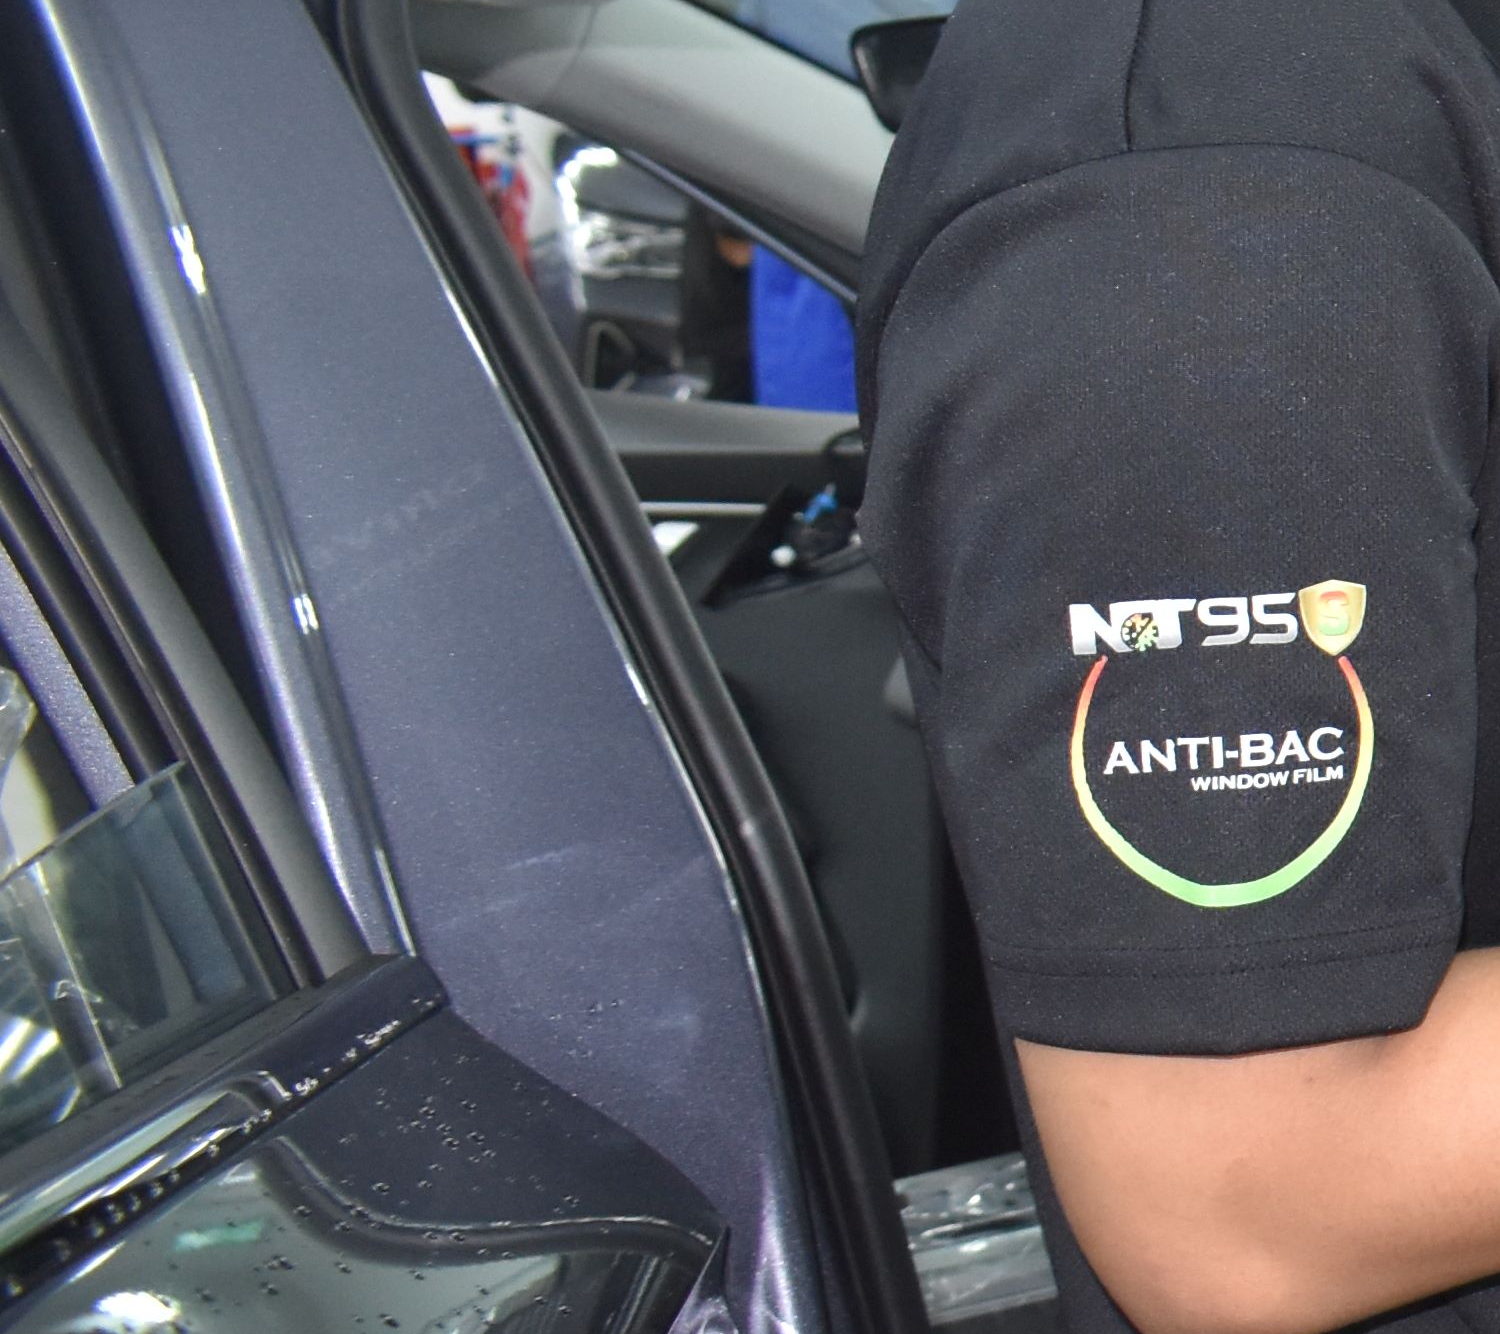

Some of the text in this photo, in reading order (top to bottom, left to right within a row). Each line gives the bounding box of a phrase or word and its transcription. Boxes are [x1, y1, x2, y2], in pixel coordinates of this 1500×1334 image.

[1103, 726, 1344, 775] ANTI-BAC
[1191, 765, 1344, 791] WINDOW FILM
